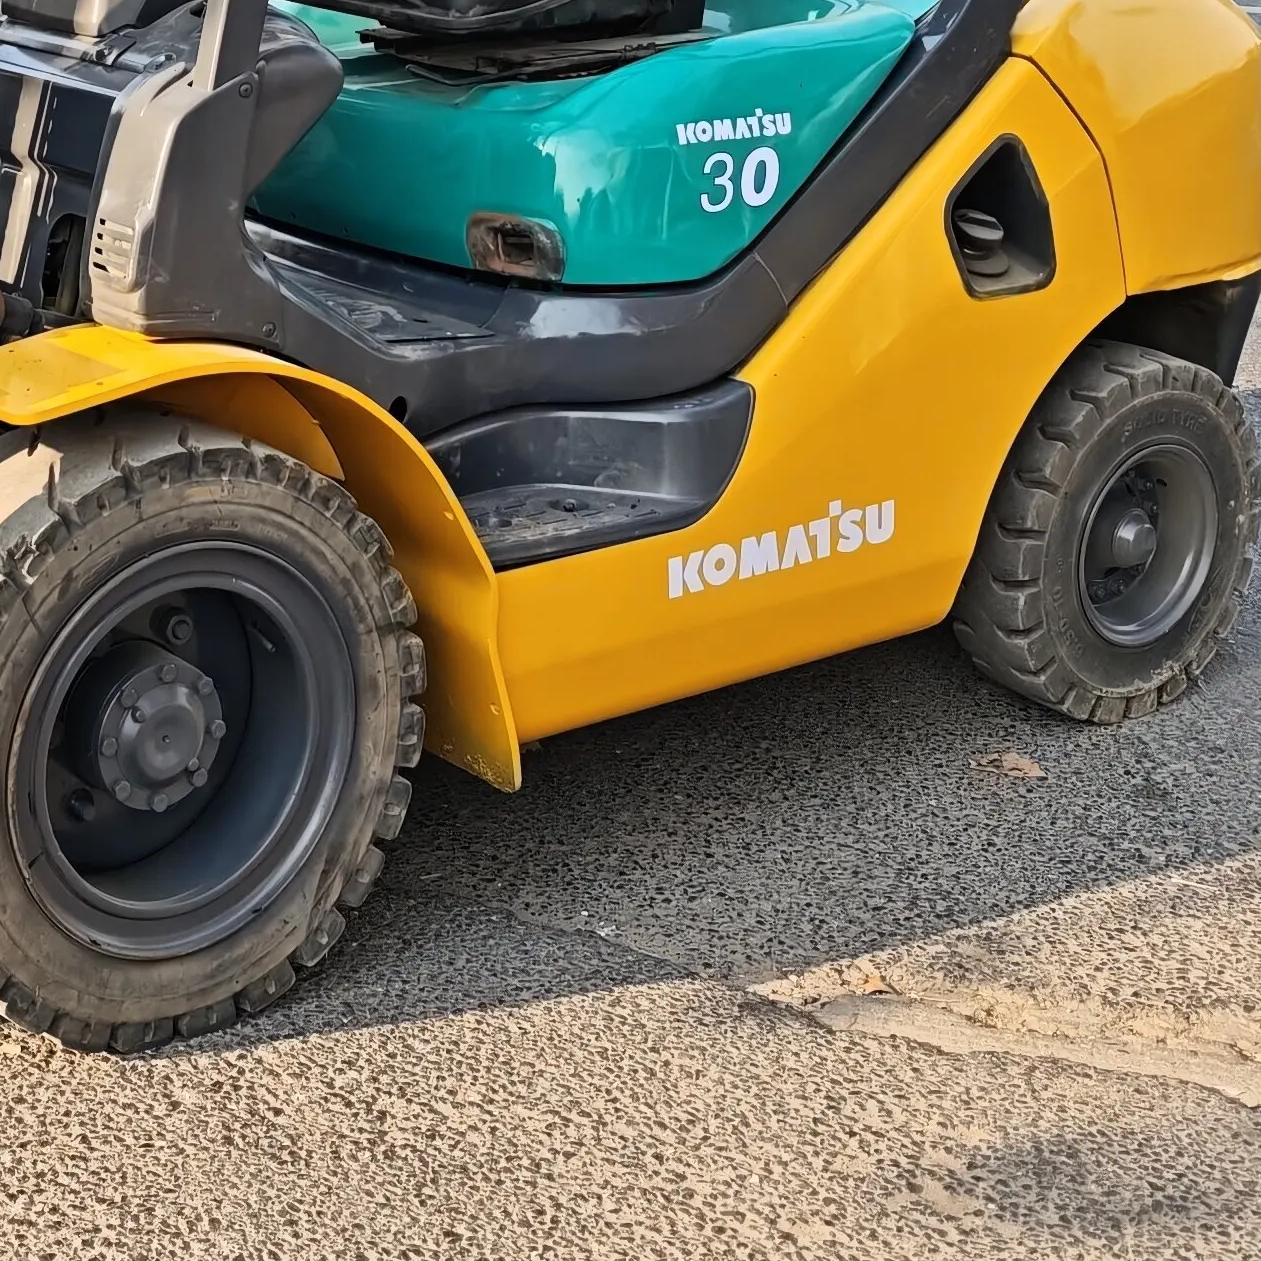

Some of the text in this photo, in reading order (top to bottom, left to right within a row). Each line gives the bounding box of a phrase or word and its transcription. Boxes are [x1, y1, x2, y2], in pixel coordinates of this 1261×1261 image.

[676, 108, 792, 145] KOMATSU
[700, 146, 780, 213] 30
[668, 499, 895, 599] KOMATSU
